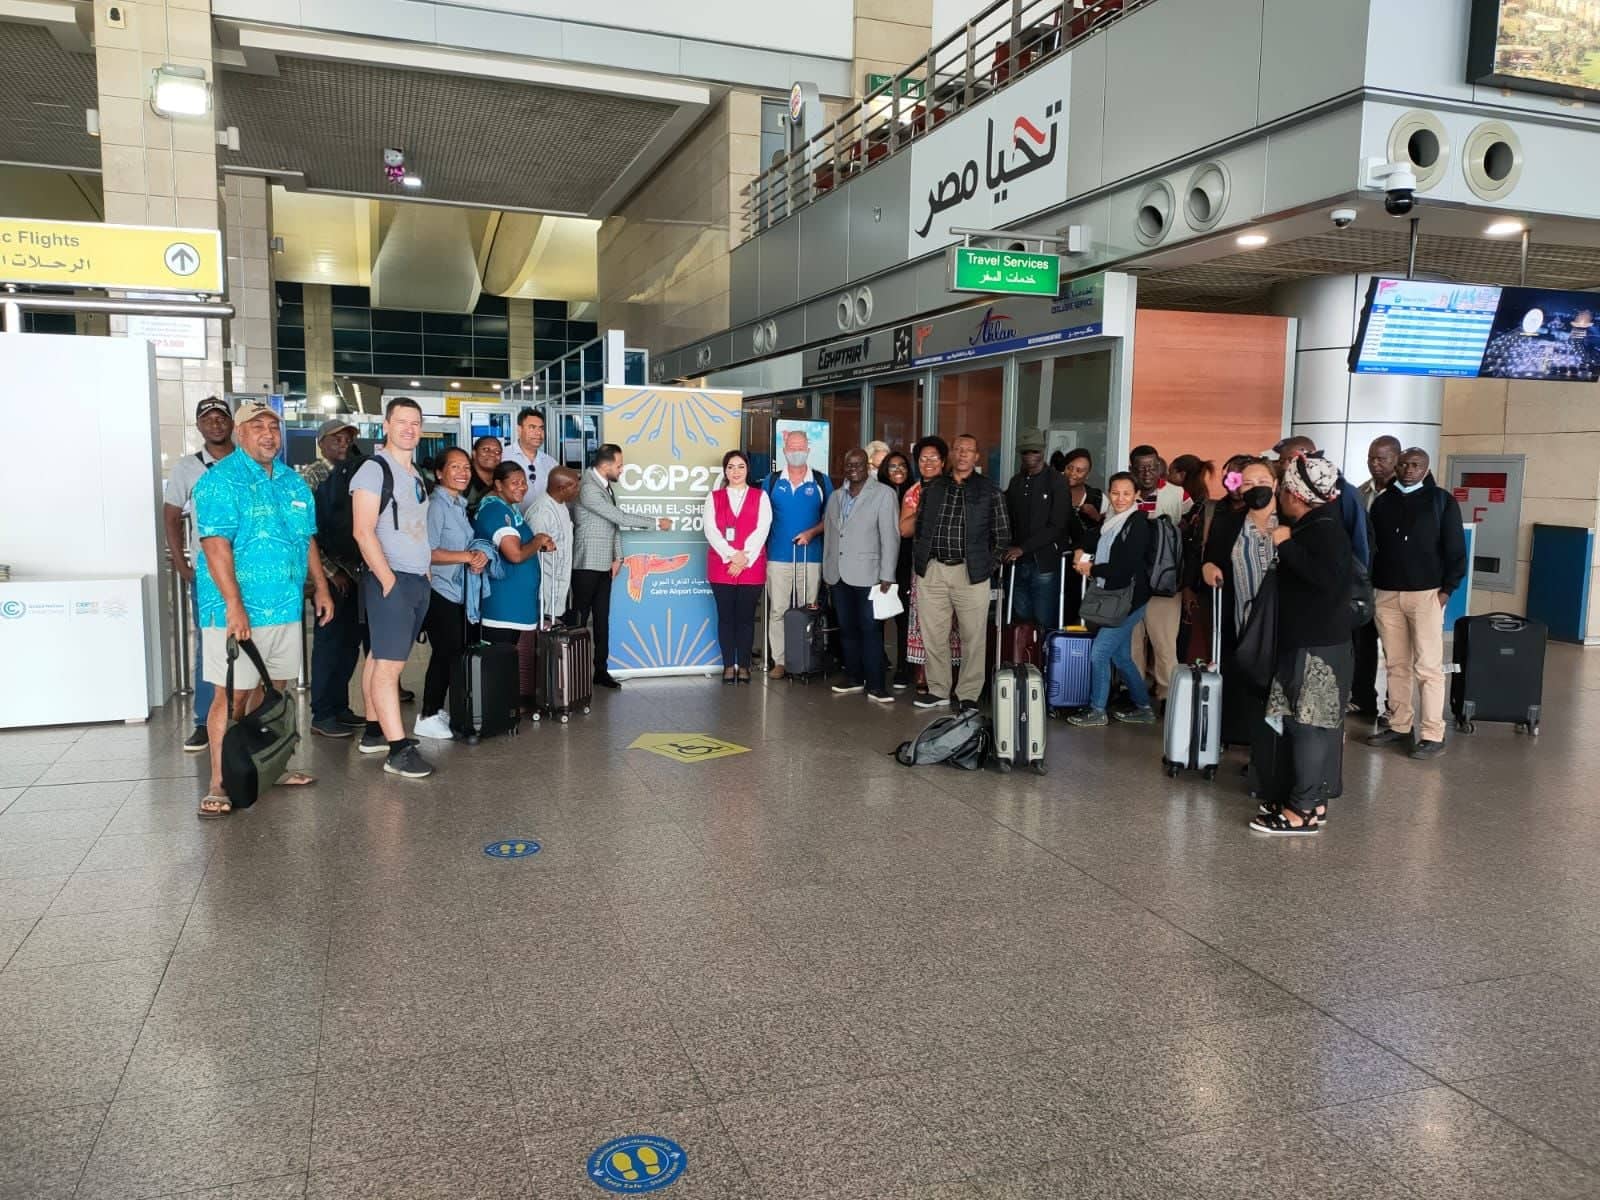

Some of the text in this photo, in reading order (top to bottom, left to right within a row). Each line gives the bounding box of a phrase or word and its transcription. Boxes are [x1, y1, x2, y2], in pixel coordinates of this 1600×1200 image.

[914, 99, 1062, 239] تحيا مصر
[18, 230, 80, 248] Flights
[966, 252, 1049, 270] Travel Services
[978, 270, 1037, 284] خدمات السفر
[969, 307, 1017, 346] Ahlan
[619, 463, 724, 492] COP27
[619, 503, 705, 515] SHARM EL-SHE
[669, 588, 691, 597] Airport
